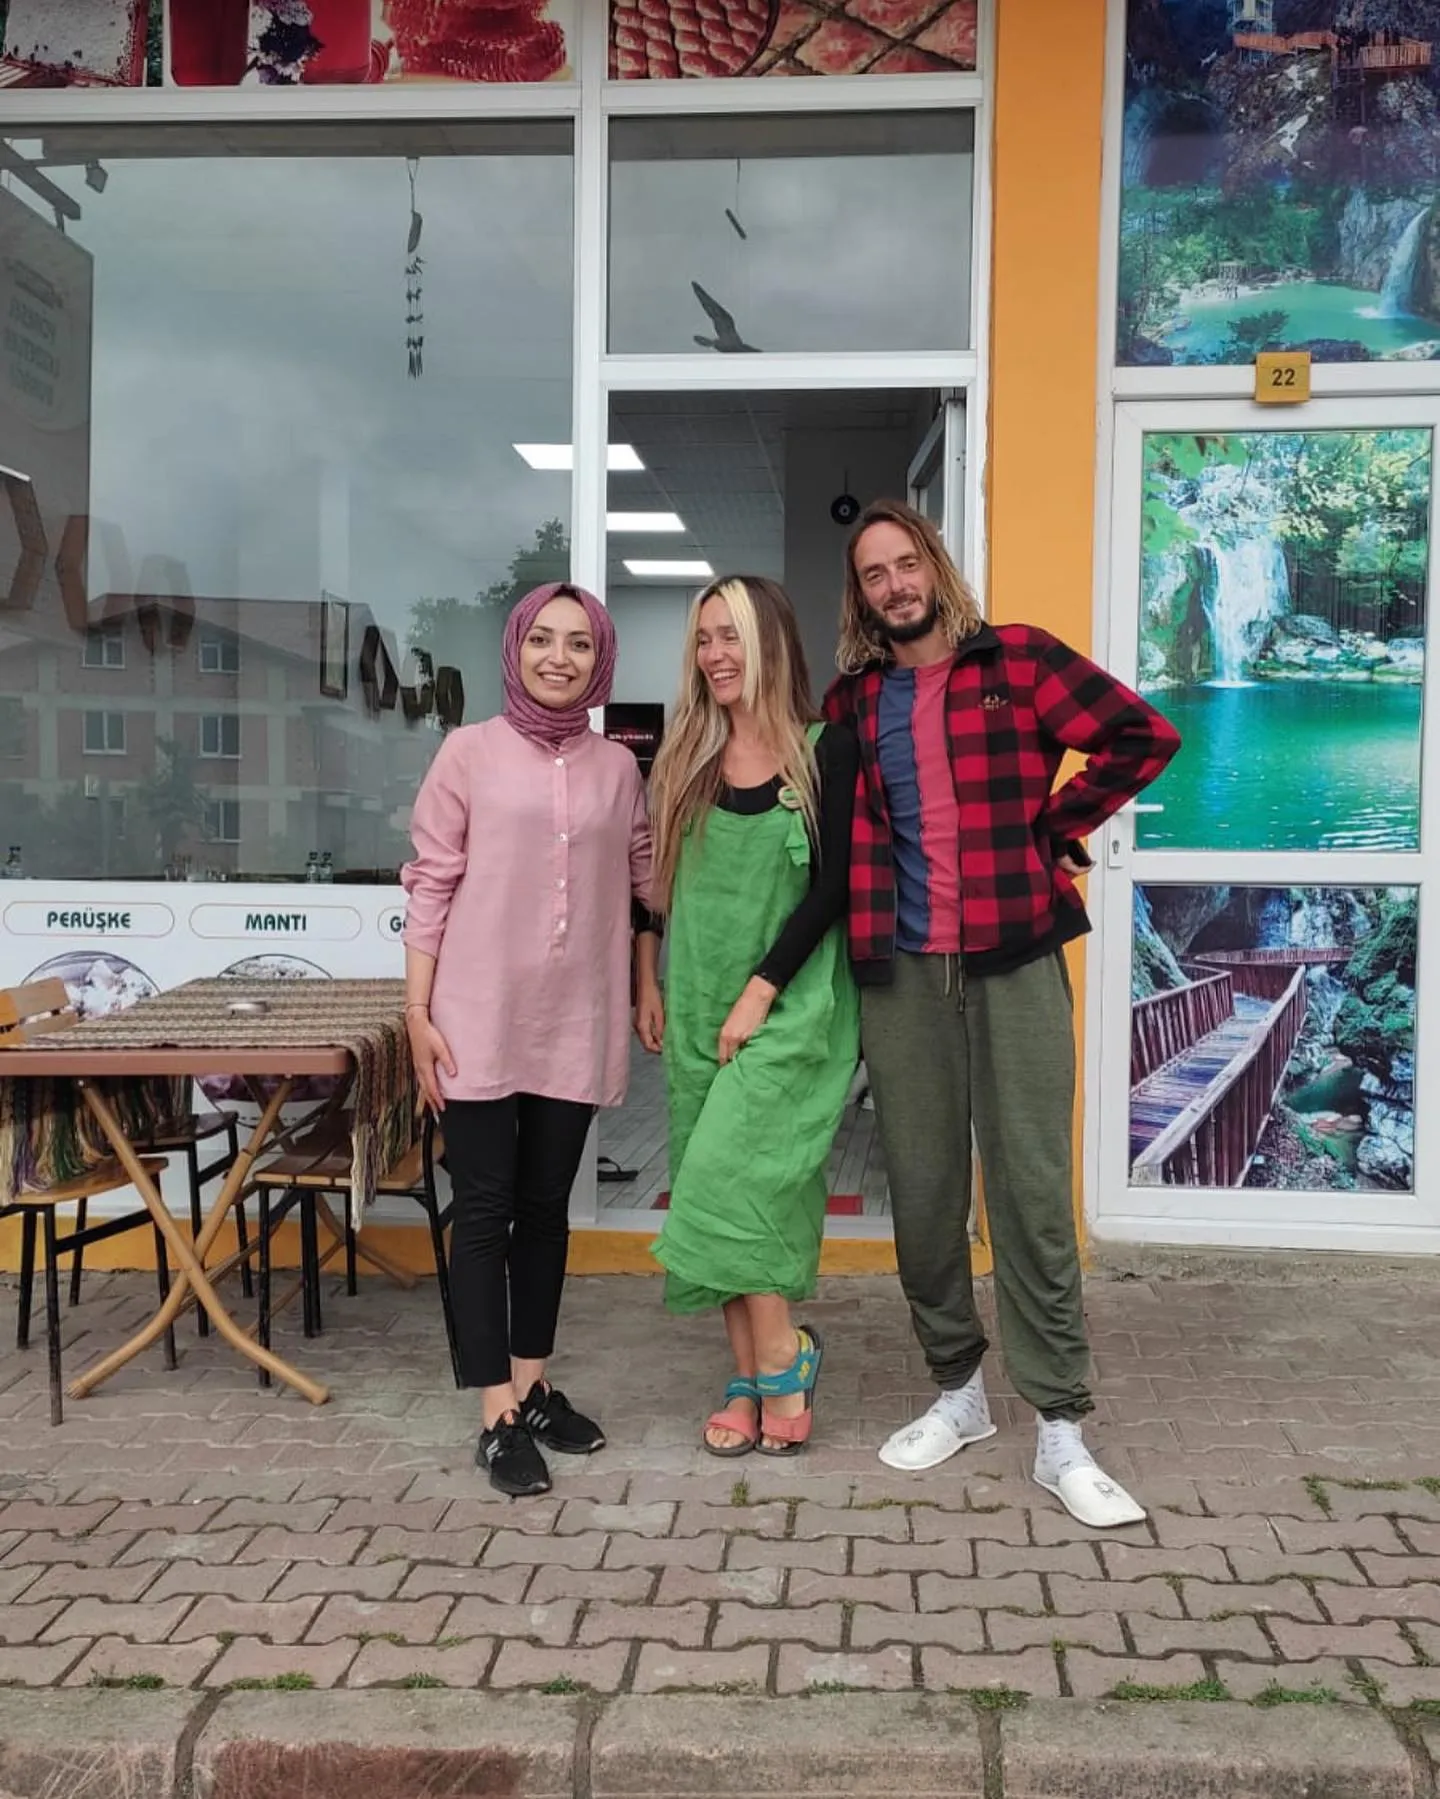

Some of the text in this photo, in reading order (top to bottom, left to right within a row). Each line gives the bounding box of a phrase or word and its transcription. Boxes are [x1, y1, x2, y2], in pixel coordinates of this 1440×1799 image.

[1271, 368, 1296, 387] 22
[46, 906, 132, 934] PERÜŞKE
[244, 913, 307, 932] MANTI
[389, 915, 407, 933] G
